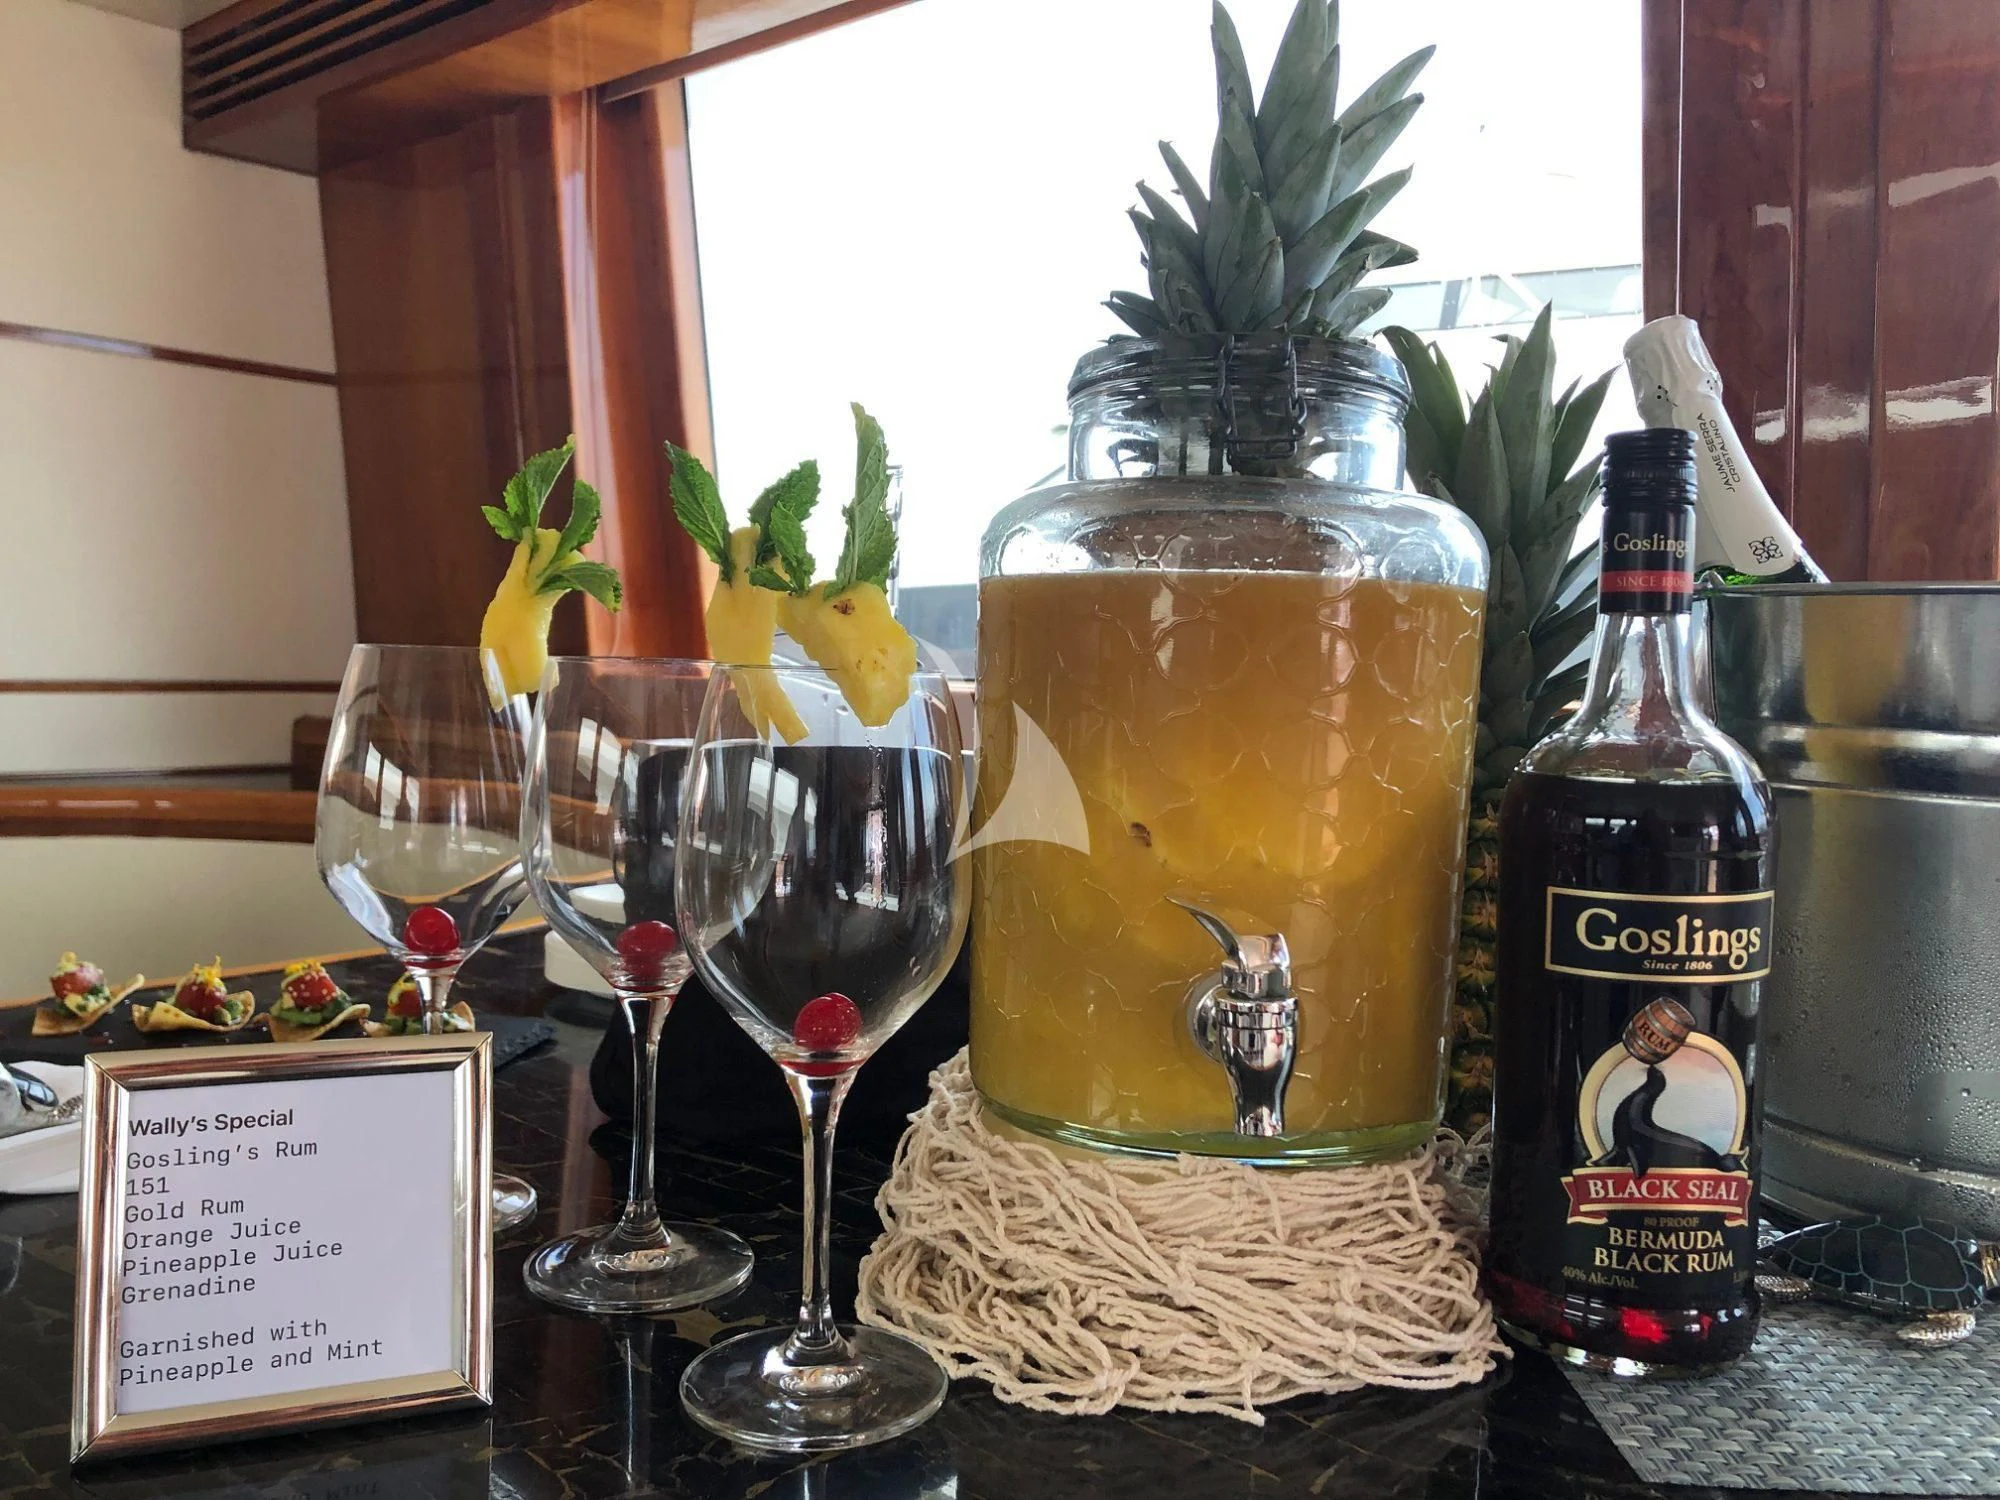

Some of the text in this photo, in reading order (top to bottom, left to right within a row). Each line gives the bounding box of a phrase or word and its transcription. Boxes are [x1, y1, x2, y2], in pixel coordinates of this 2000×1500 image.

[1697, 413, 1736, 493] JAUME SERRA
[1709, 419, 1740, 483] CRISTALINO
[1616, 575, 1656, 587] SINCE
[1576, 907, 1761, 970] Goslings
[1642, 959, 1713, 970] Since 1806
[1638, 1021, 1672, 1052] RUM
[214, 1109, 294, 1133] Special
[276, 1140, 318, 1159] Rum
[126, 1176, 170, 1196] 151
[1586, 1179, 1740, 1201] BLACK SEAL
[124, 1199, 245, 1223] Gold Rum
[1659, 1217, 1700, 1228] PROOF
[123, 1218, 301, 1250] Orange Juice
[1608, 1227, 1725, 1250] BERMUDA
[122, 1240, 343, 1277] Pineapple Juice
[1594, 1247, 1734, 1274] BLACK RUM
[1561, 1264, 1587, 1282] 40%
[121, 1275, 256, 1304] Grenadine
[120, 1319, 328, 1359] Garnished with
[119, 1339, 383, 1386] Pineapple and Mint
